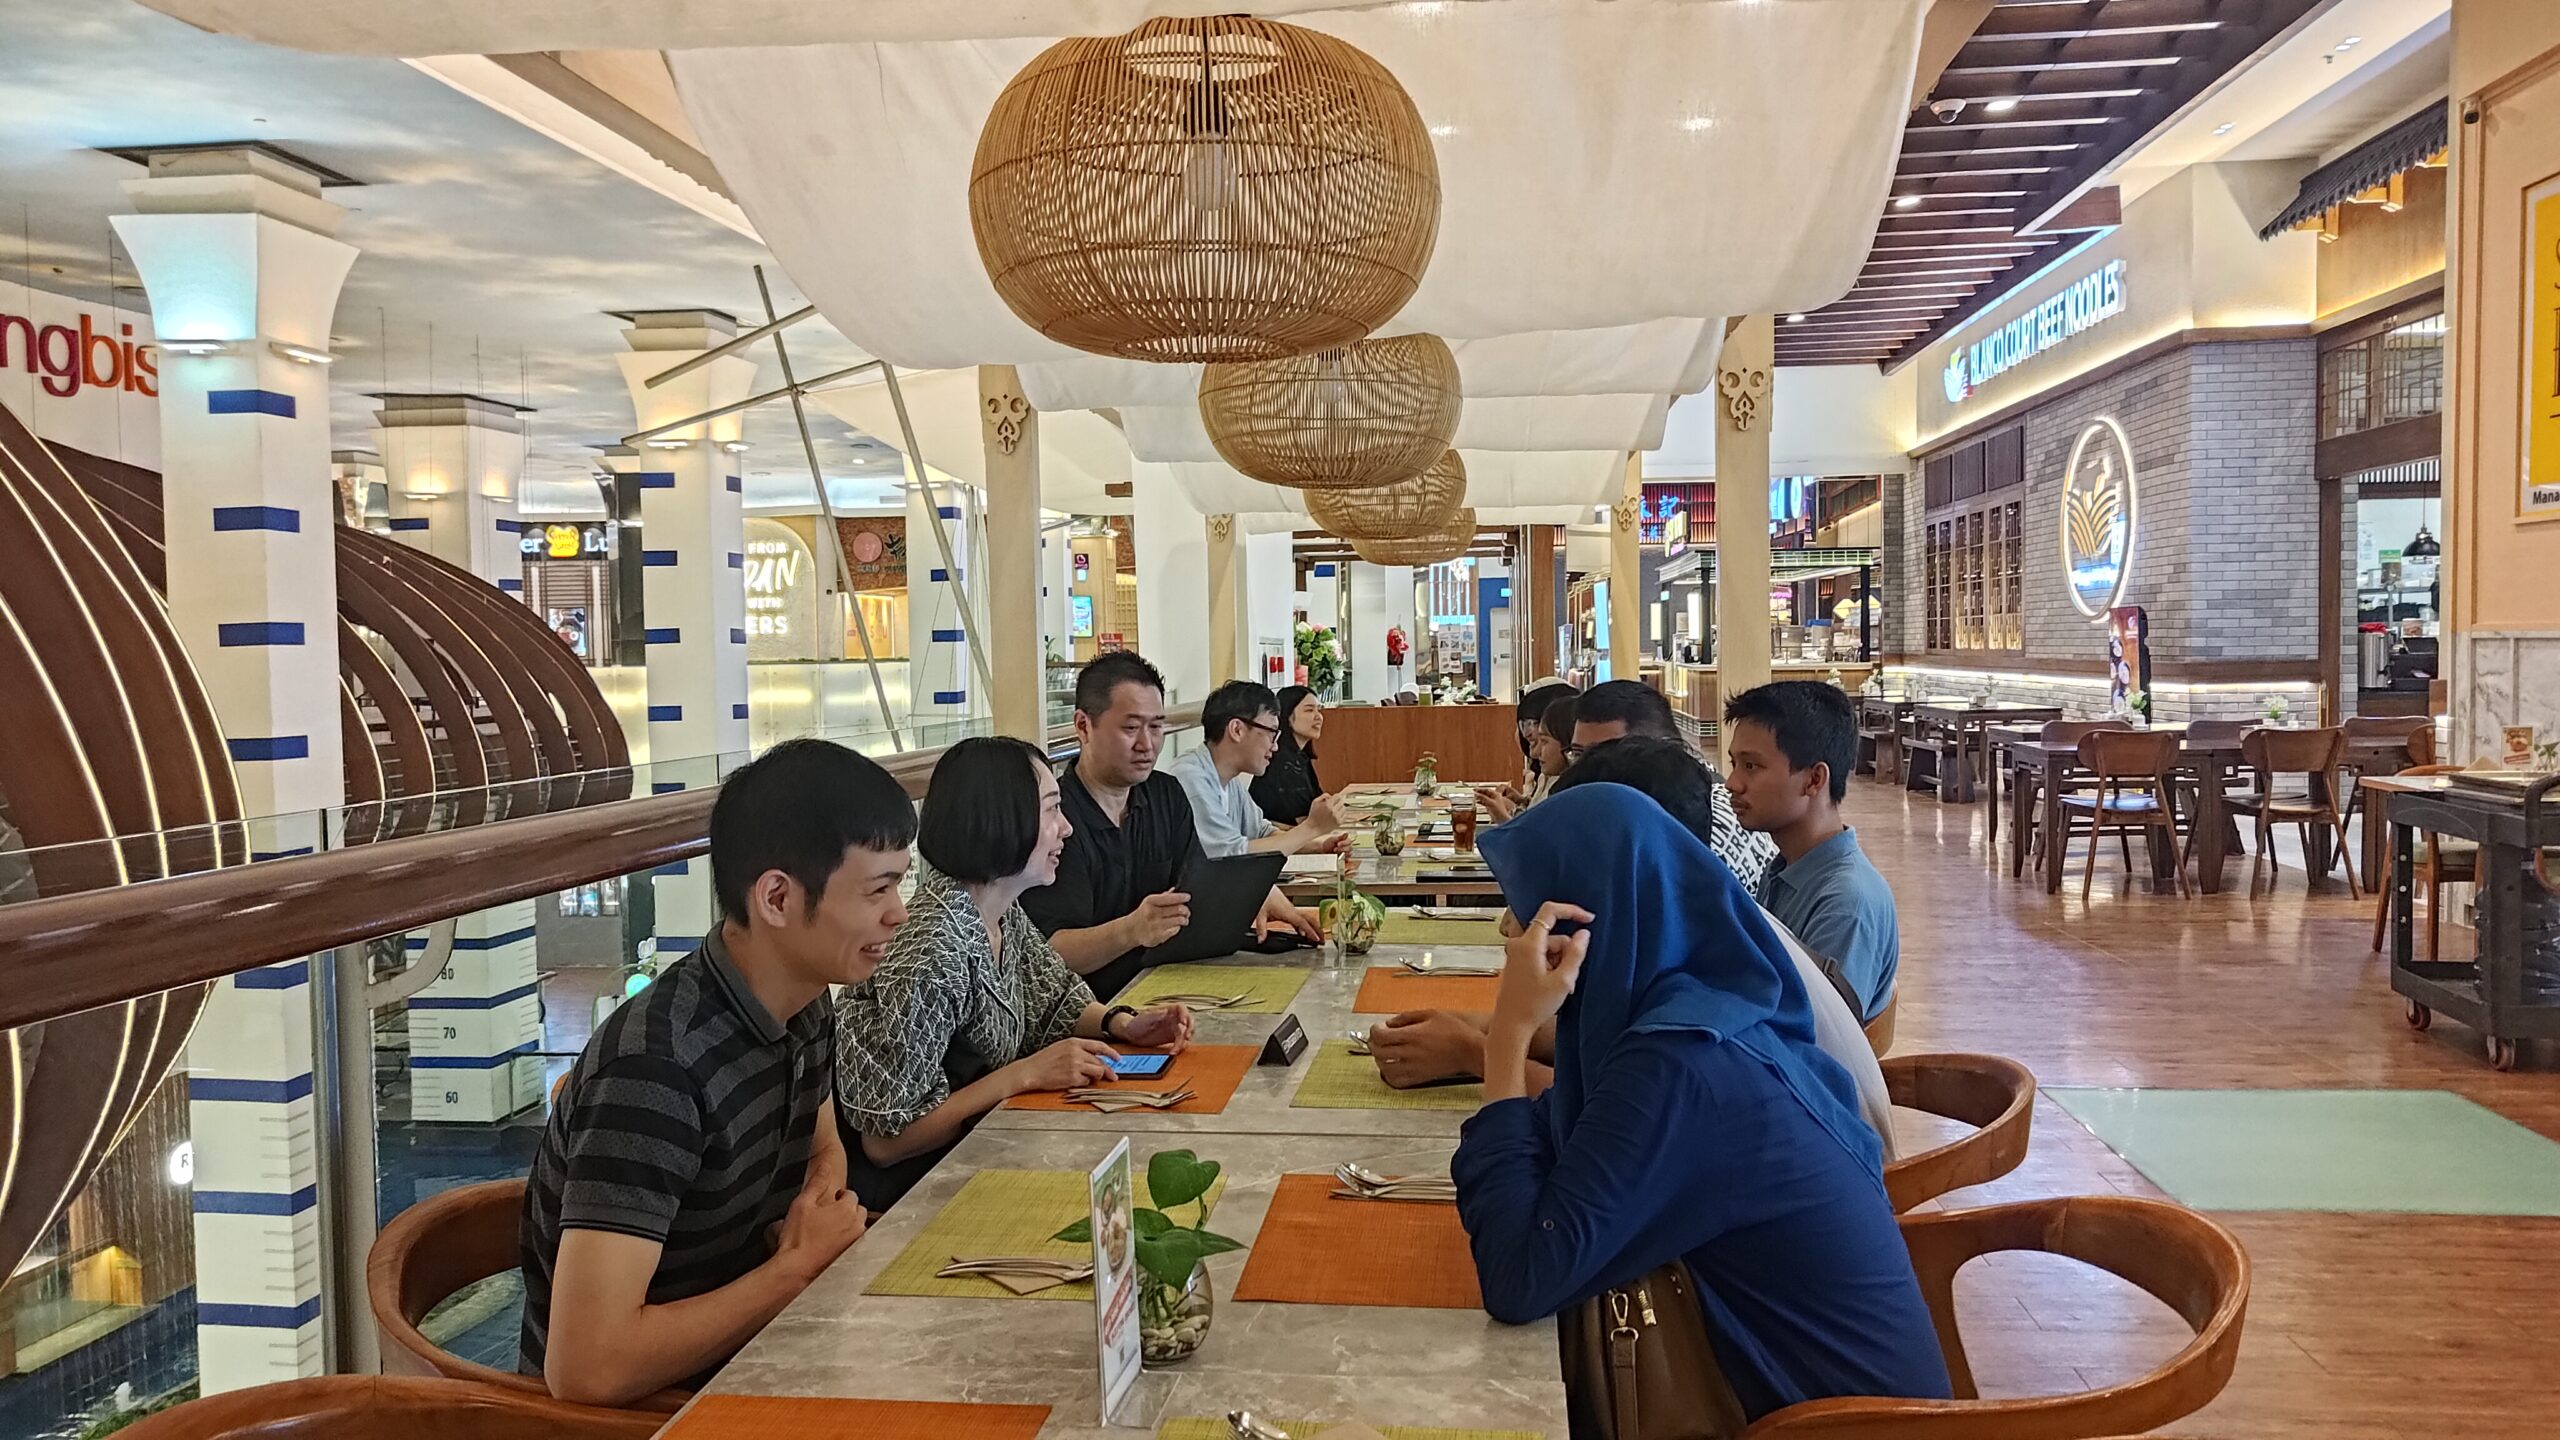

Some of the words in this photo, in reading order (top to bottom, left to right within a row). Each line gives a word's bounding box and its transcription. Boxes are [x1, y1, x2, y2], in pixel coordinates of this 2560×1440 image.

[1969, 328, 2006, 386] BLANCO
[2005, 307, 2039, 368] COURT
[2037, 291, 2067, 351] BEEF
[2065, 258, 2123, 337] NOODLES
[747, 542, 787, 554] FROM
[443, 1027, 457, 1039] 70
[445, 1091, 459, 1104] 60
